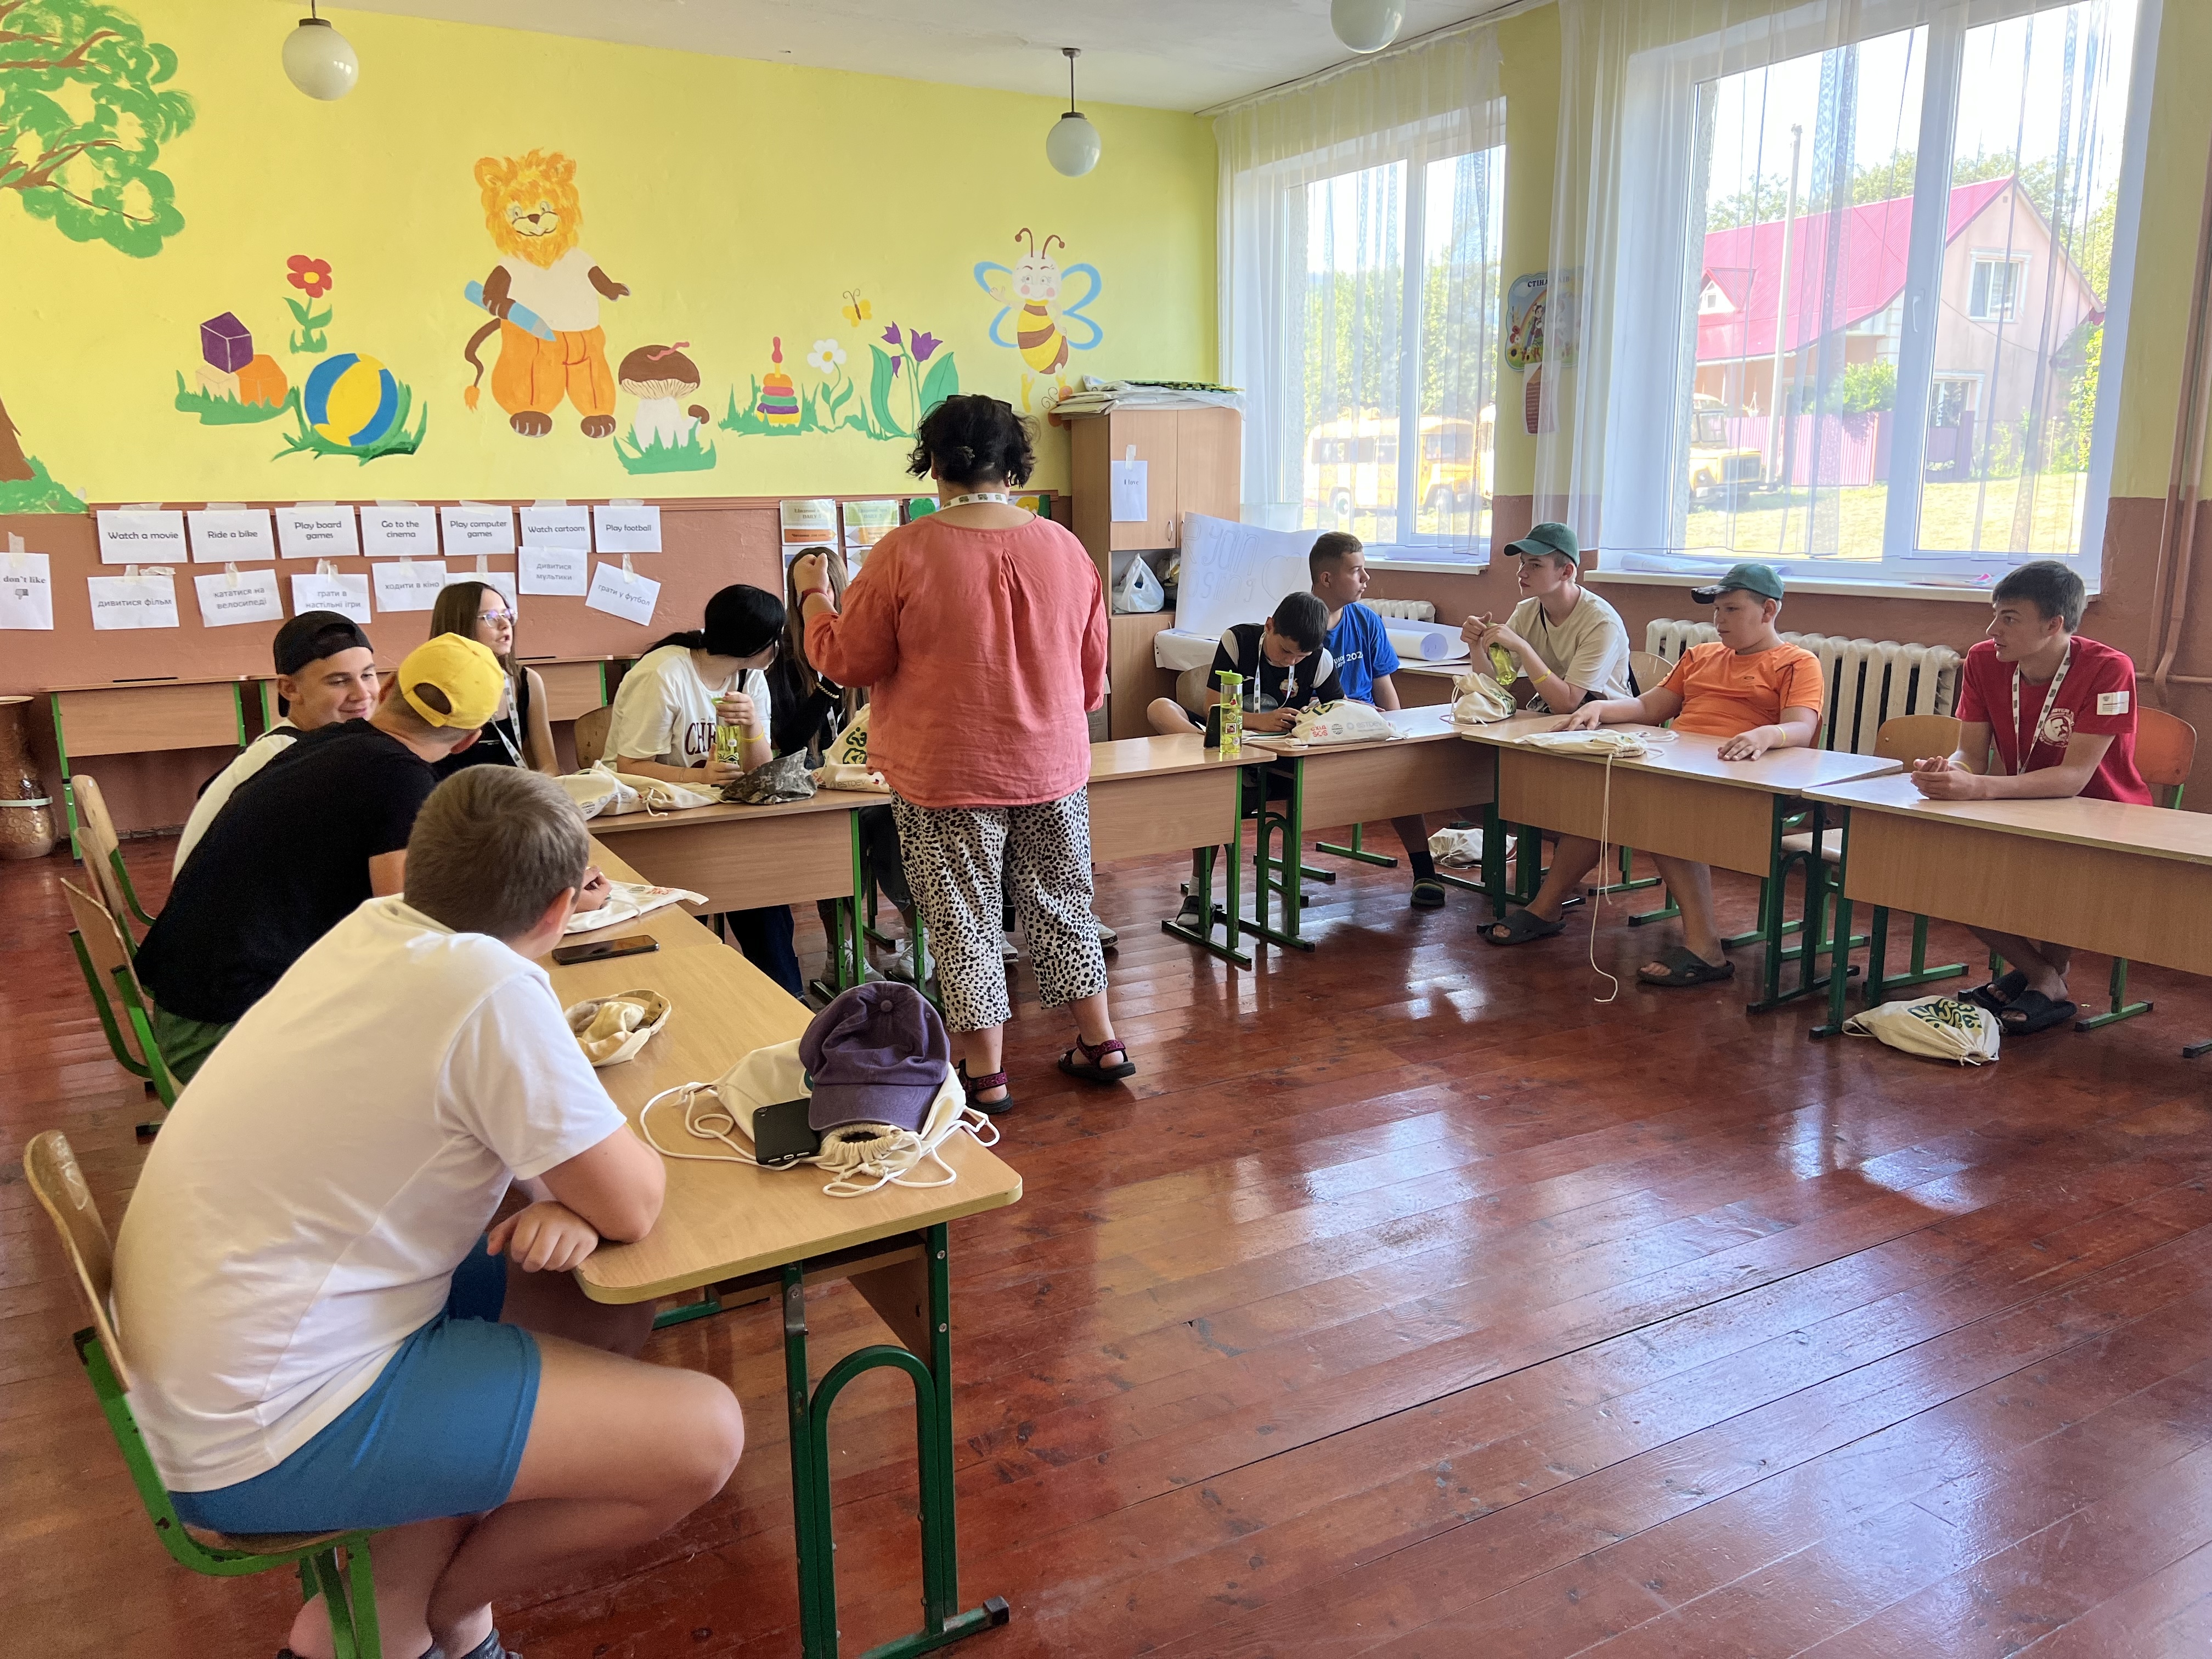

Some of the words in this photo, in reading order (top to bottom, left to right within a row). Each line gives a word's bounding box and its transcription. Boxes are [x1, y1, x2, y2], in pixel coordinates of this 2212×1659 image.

[294, 522, 314, 531] Play
[315, 521, 342, 529] board
[381, 520, 393, 528] Go
[449, 520, 469, 529] Play
[469, 520, 507, 529] computer
[605, 524, 623, 533] Play
[108, 532, 139, 540] Watch
[207, 531, 228, 539] Ride
[306, 533, 334, 541] games
[1183, 518, 1260, 576] Ryan
[535, 573, 573, 582] мультики
[213, 589, 252, 598] кататися
[317, 590, 340, 599] грати
[597, 584, 618, 595] грати
[625, 592, 650, 606] футбол
[97, 600, 142, 608] дивитися
[144, 598, 172, 607] фільм
[216, 598, 268, 610] велосипеді
[345, 601, 361, 610] ігри
